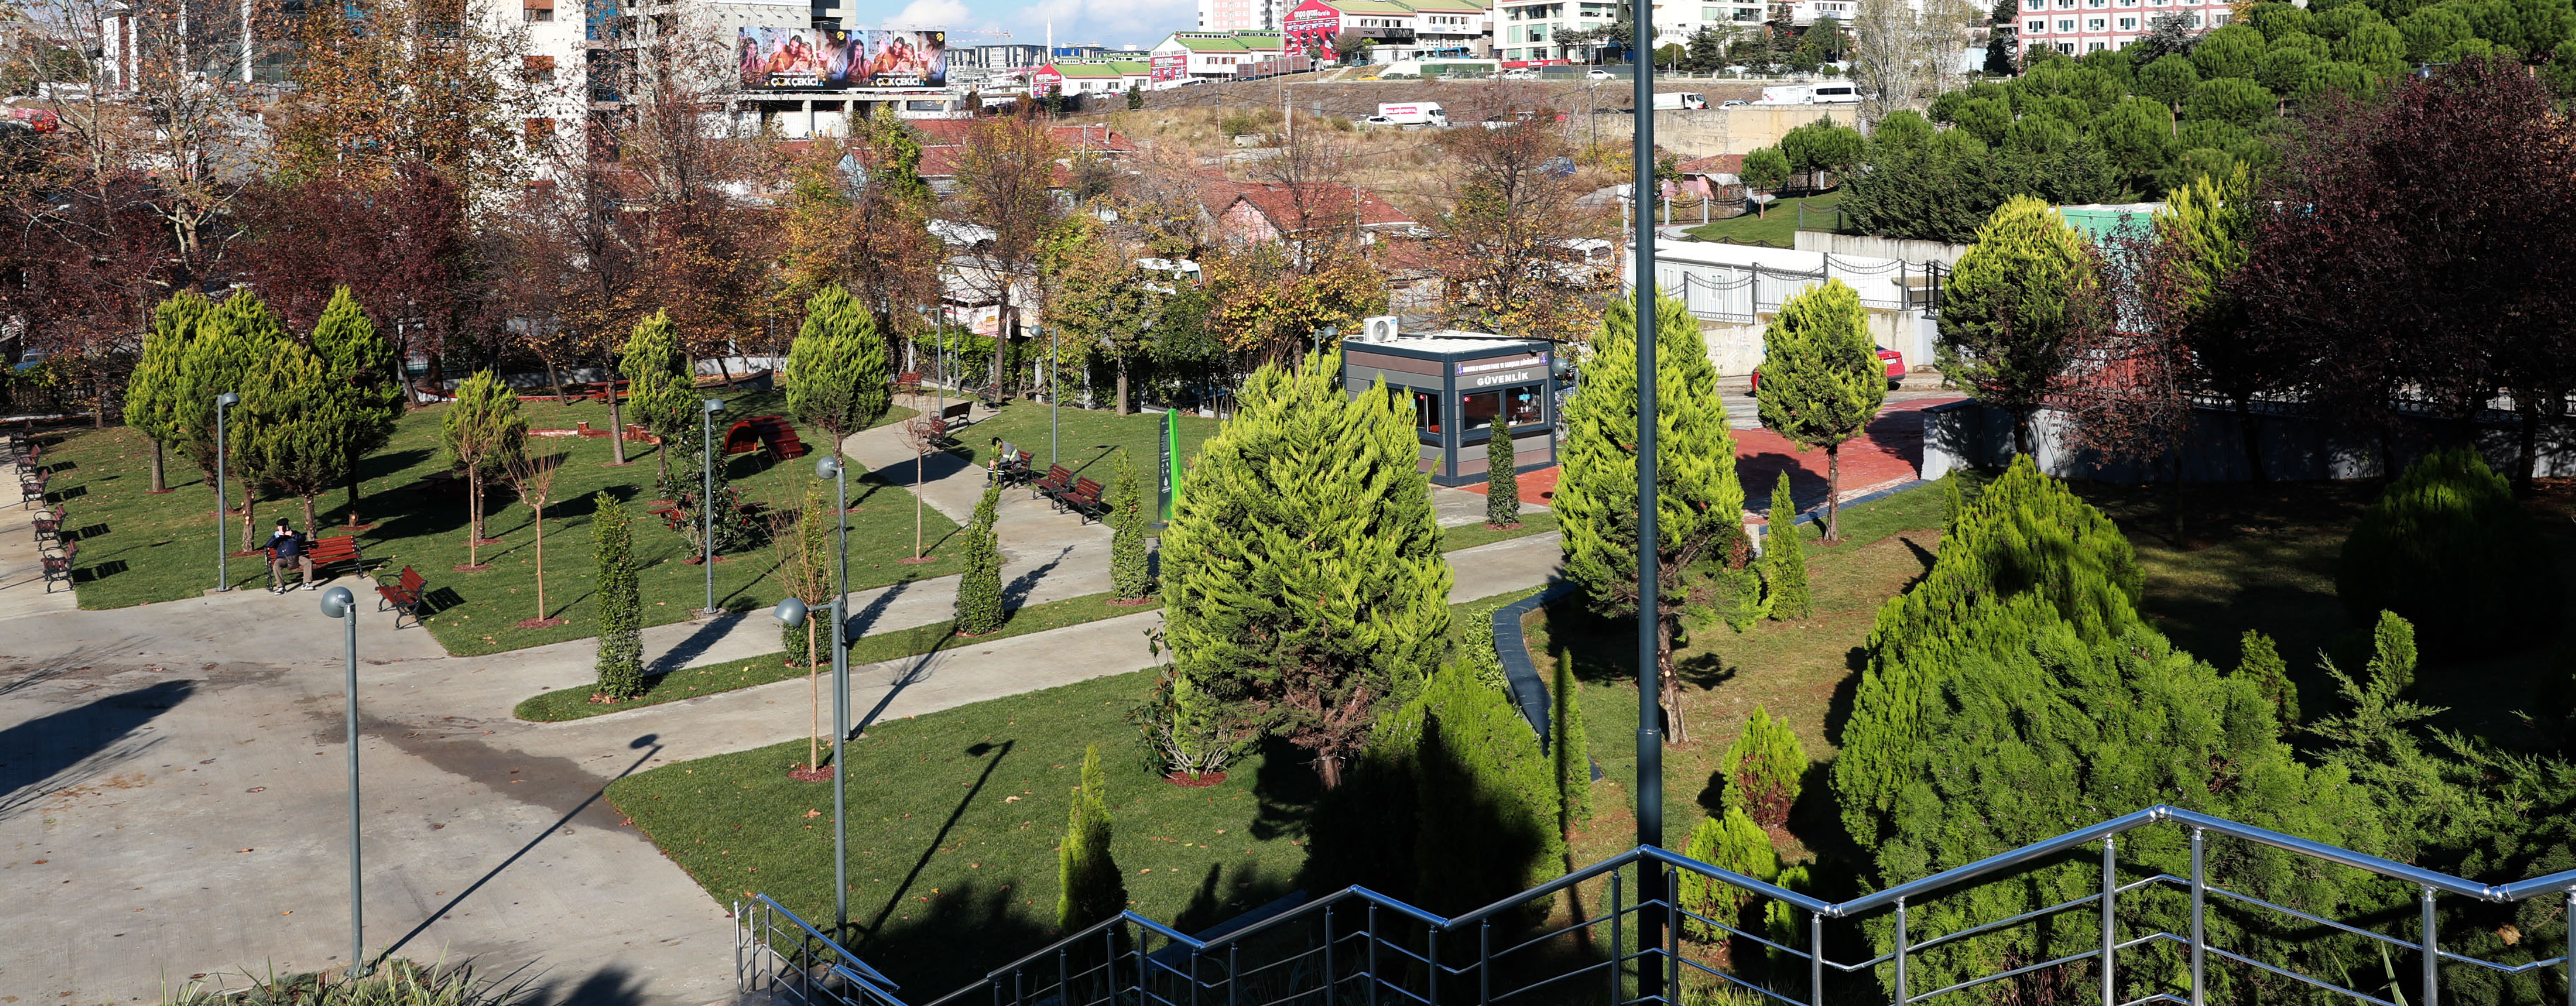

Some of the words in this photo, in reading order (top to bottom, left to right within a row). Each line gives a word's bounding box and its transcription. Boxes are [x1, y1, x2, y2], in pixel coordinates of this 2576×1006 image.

[792, 76, 818, 87] ÇEKİCİ
[895, 76, 919, 87] ÇEKİCİ
[1477, 371, 1529, 386] GÜVENLİK
